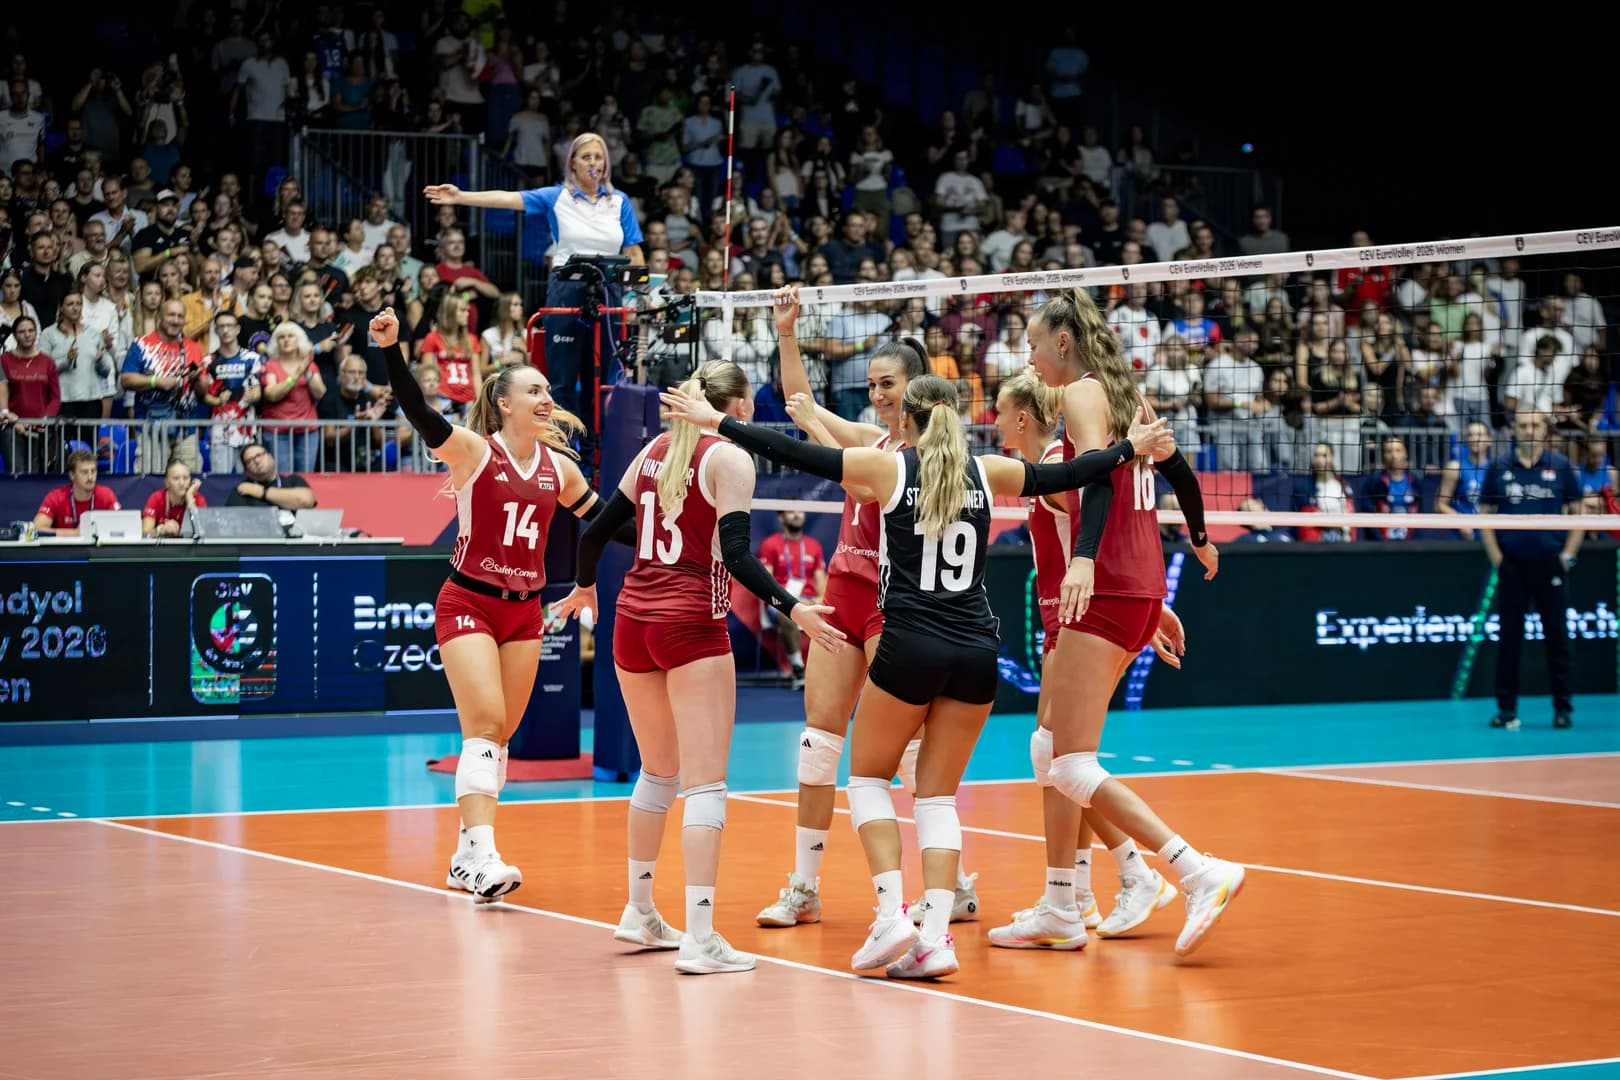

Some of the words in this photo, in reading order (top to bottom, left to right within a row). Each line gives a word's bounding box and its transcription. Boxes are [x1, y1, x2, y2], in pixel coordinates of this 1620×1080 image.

[1360, 249, 1375, 261] CEV
[1376, 246, 1414, 260] EuroVolley
[1416, 245, 1435, 257] 2026
[1436, 244, 1465, 256] Women
[1576, 232, 1594, 244] CEV
[1169, 264, 1183, 274] CEV
[1184, 262, 1217, 274] EuroVolley
[1236, 260, 1263, 270] Women
[503, 502, 539, 549] 14
[639, 490, 684, 565] 13
[914, 520, 978, 592] 19
[0, 579, 82, 625] dyol
[353, 595, 436, 630] Brno
[455, 614, 476, 630] 14
[1316, 605, 1501, 651] Experience
[352, 639, 444, 672] Czec
